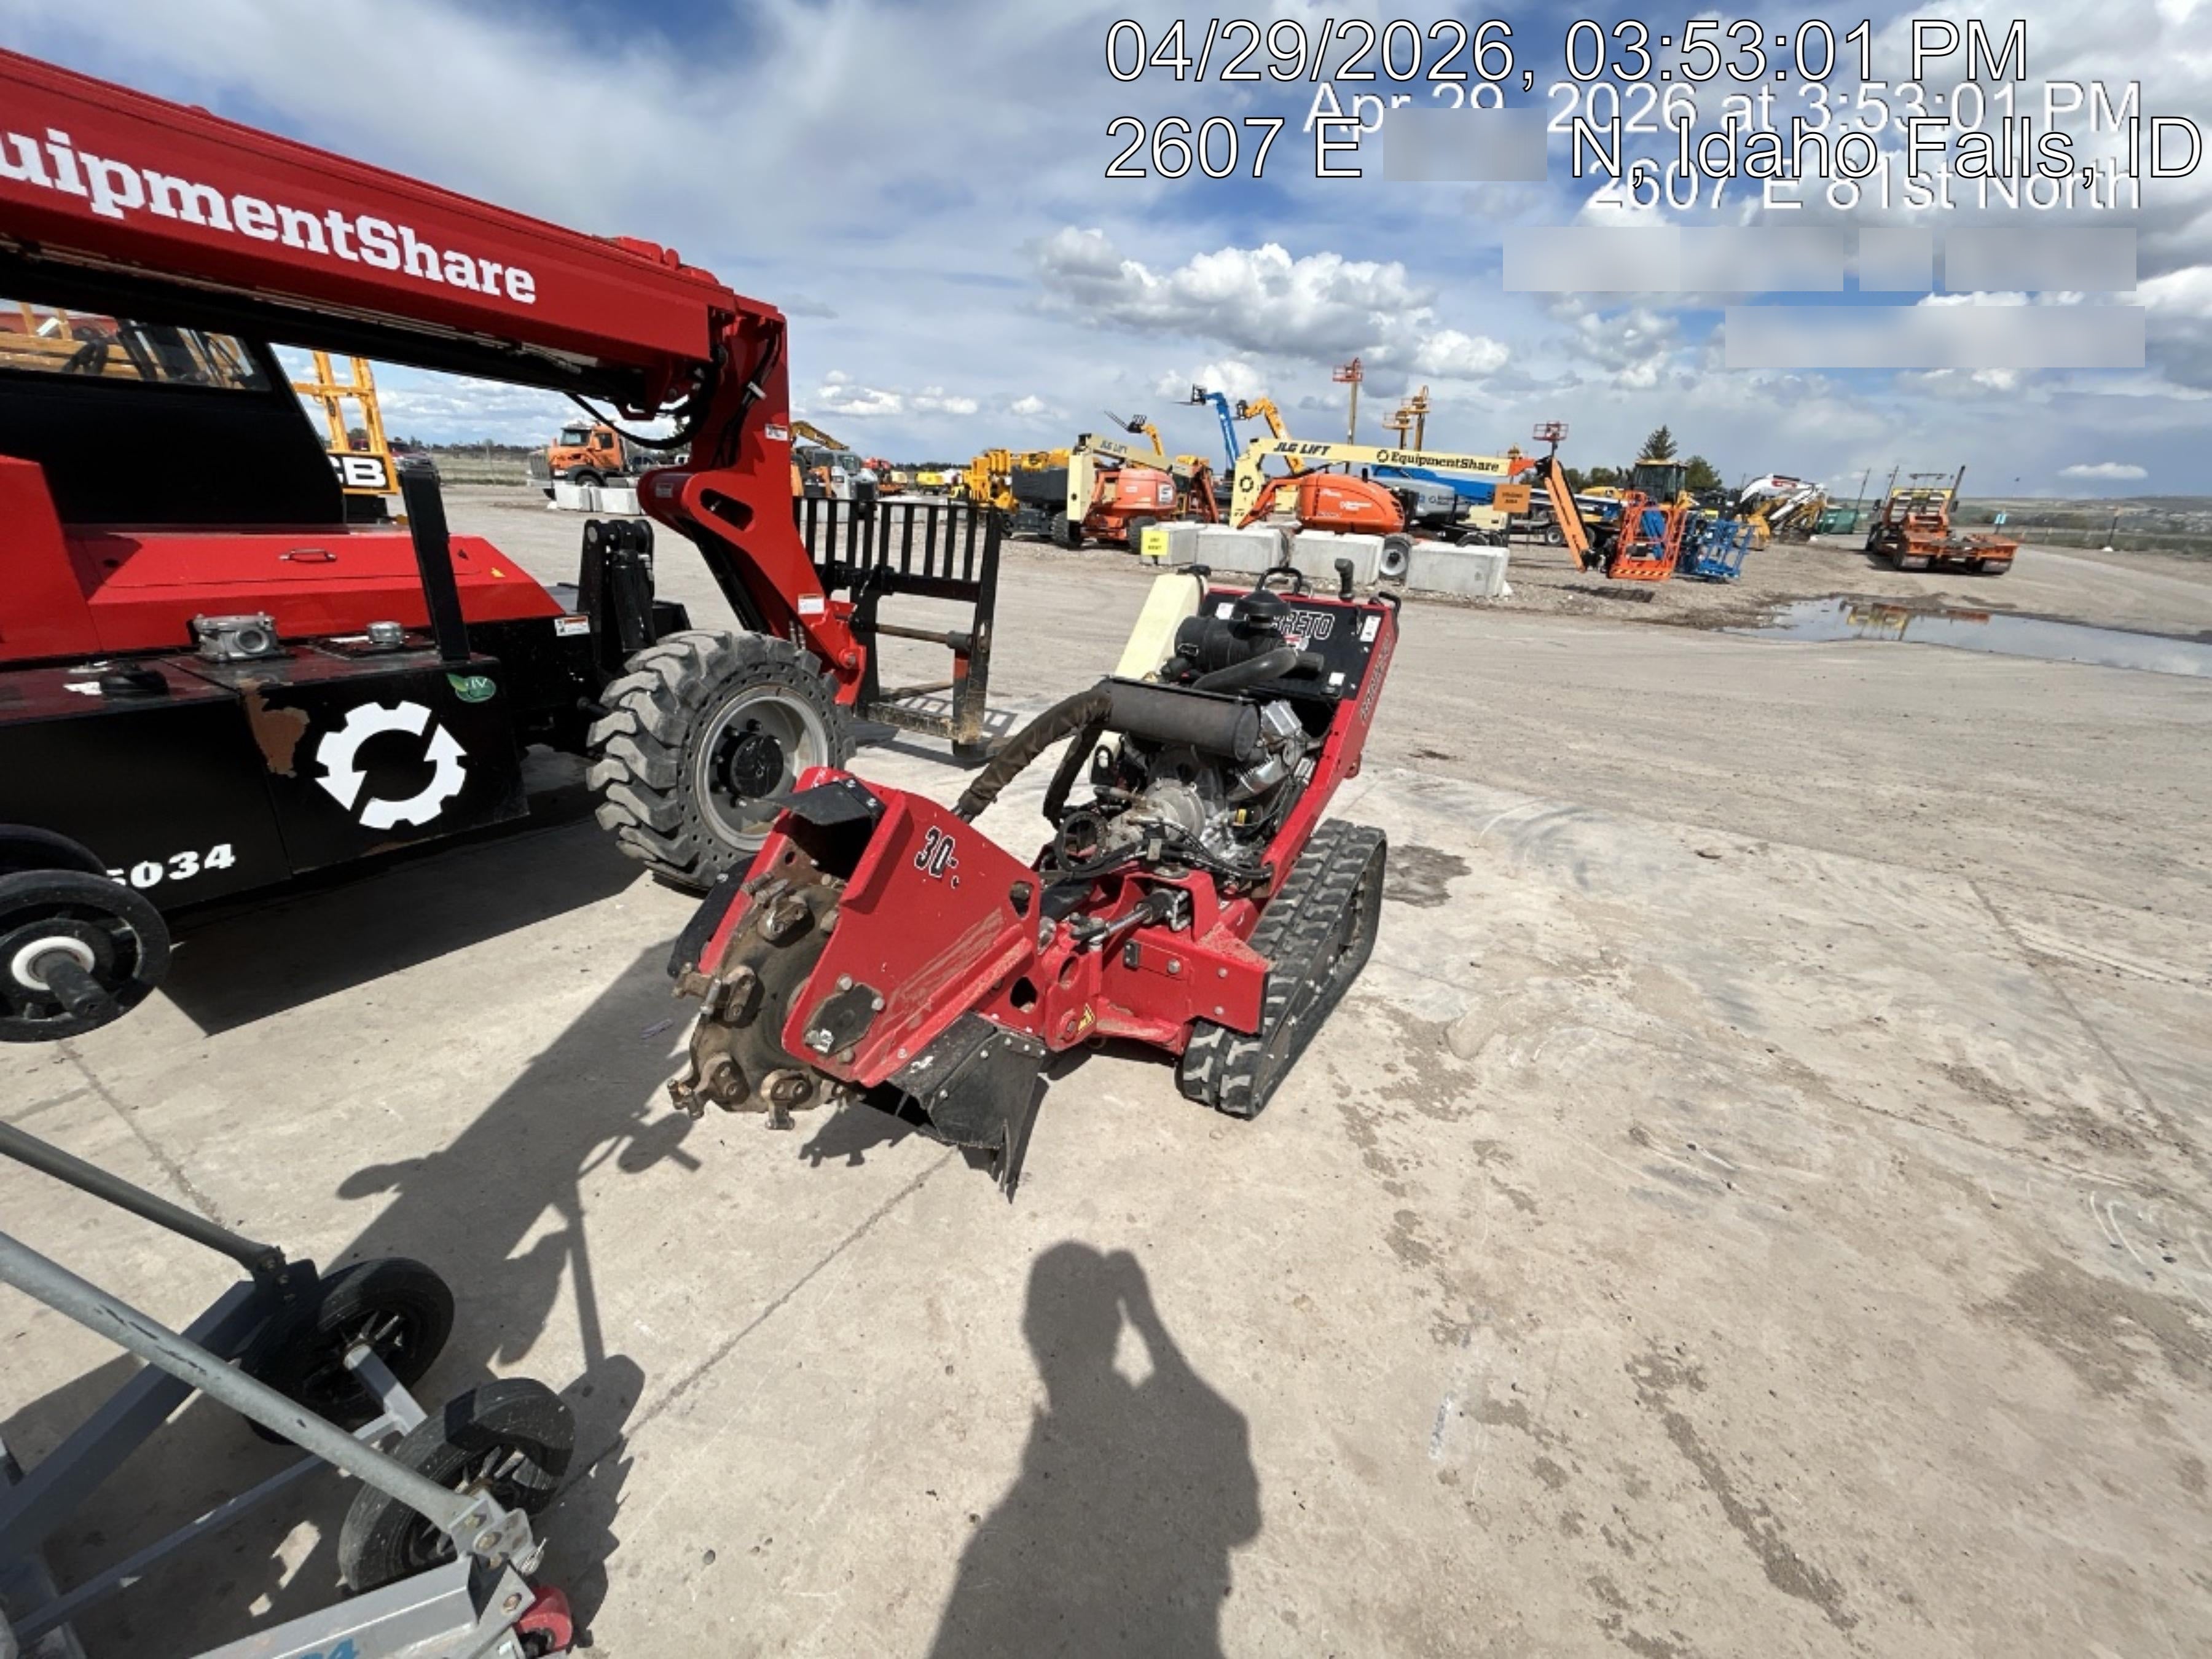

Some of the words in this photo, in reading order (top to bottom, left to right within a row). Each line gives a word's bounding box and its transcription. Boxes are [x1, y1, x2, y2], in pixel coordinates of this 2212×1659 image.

[1274, 442, 1298, 452] JLG
[1300, 444, 1332, 456] LIFT
[1390, 452, 1500, 473] EquipmentShare
